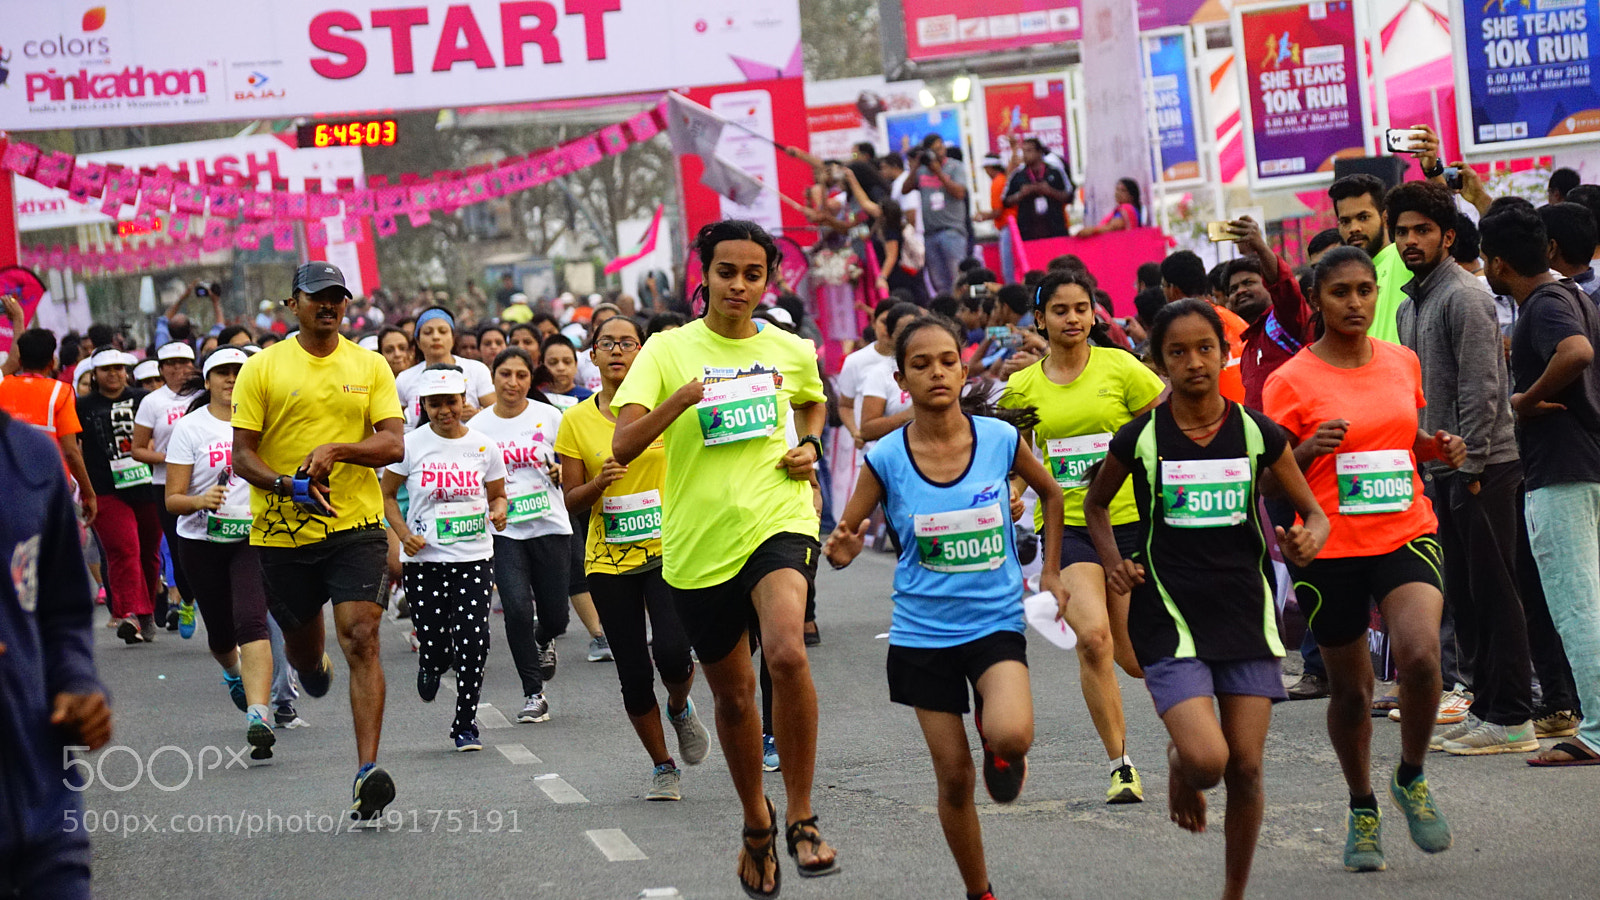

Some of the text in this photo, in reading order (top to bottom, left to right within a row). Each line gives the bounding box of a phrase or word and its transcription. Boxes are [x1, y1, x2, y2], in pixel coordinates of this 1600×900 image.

[1481, 9, 1588, 41] SHE TEAMS
[23, 33, 110, 60] colors
[308, 0, 621, 80] START
[1484, 32, 1590, 70] 10K RUN
[26, 66, 207, 103] Pinkathon
[1260, 64, 1346, 92] SHE TEAMS
[1544, 68, 1564, 80] Mar
[234, 89, 286, 101] BAJAJ
[1262, 83, 1349, 115] 10K RUN
[314, 120, 397, 149] 6:45:03
[723, 403, 777, 429] 50104
[428, 462, 448, 470] AM
[451, 462, 460, 470] A
[503, 446, 539, 465] NK
[123, 466, 150, 481] 53131
[1068, 459, 1104, 477] 501
[421, 471, 480, 488] PINK
[1362, 478, 1413, 499] 50096
[515, 495, 550, 514] 50099
[970, 490, 1001, 507] JSW
[1187, 489, 1246, 512] 50101
[452, 518, 485, 536] 50050
[619, 512, 662, 532] 50038
[944, 534, 1004, 561] 50040
